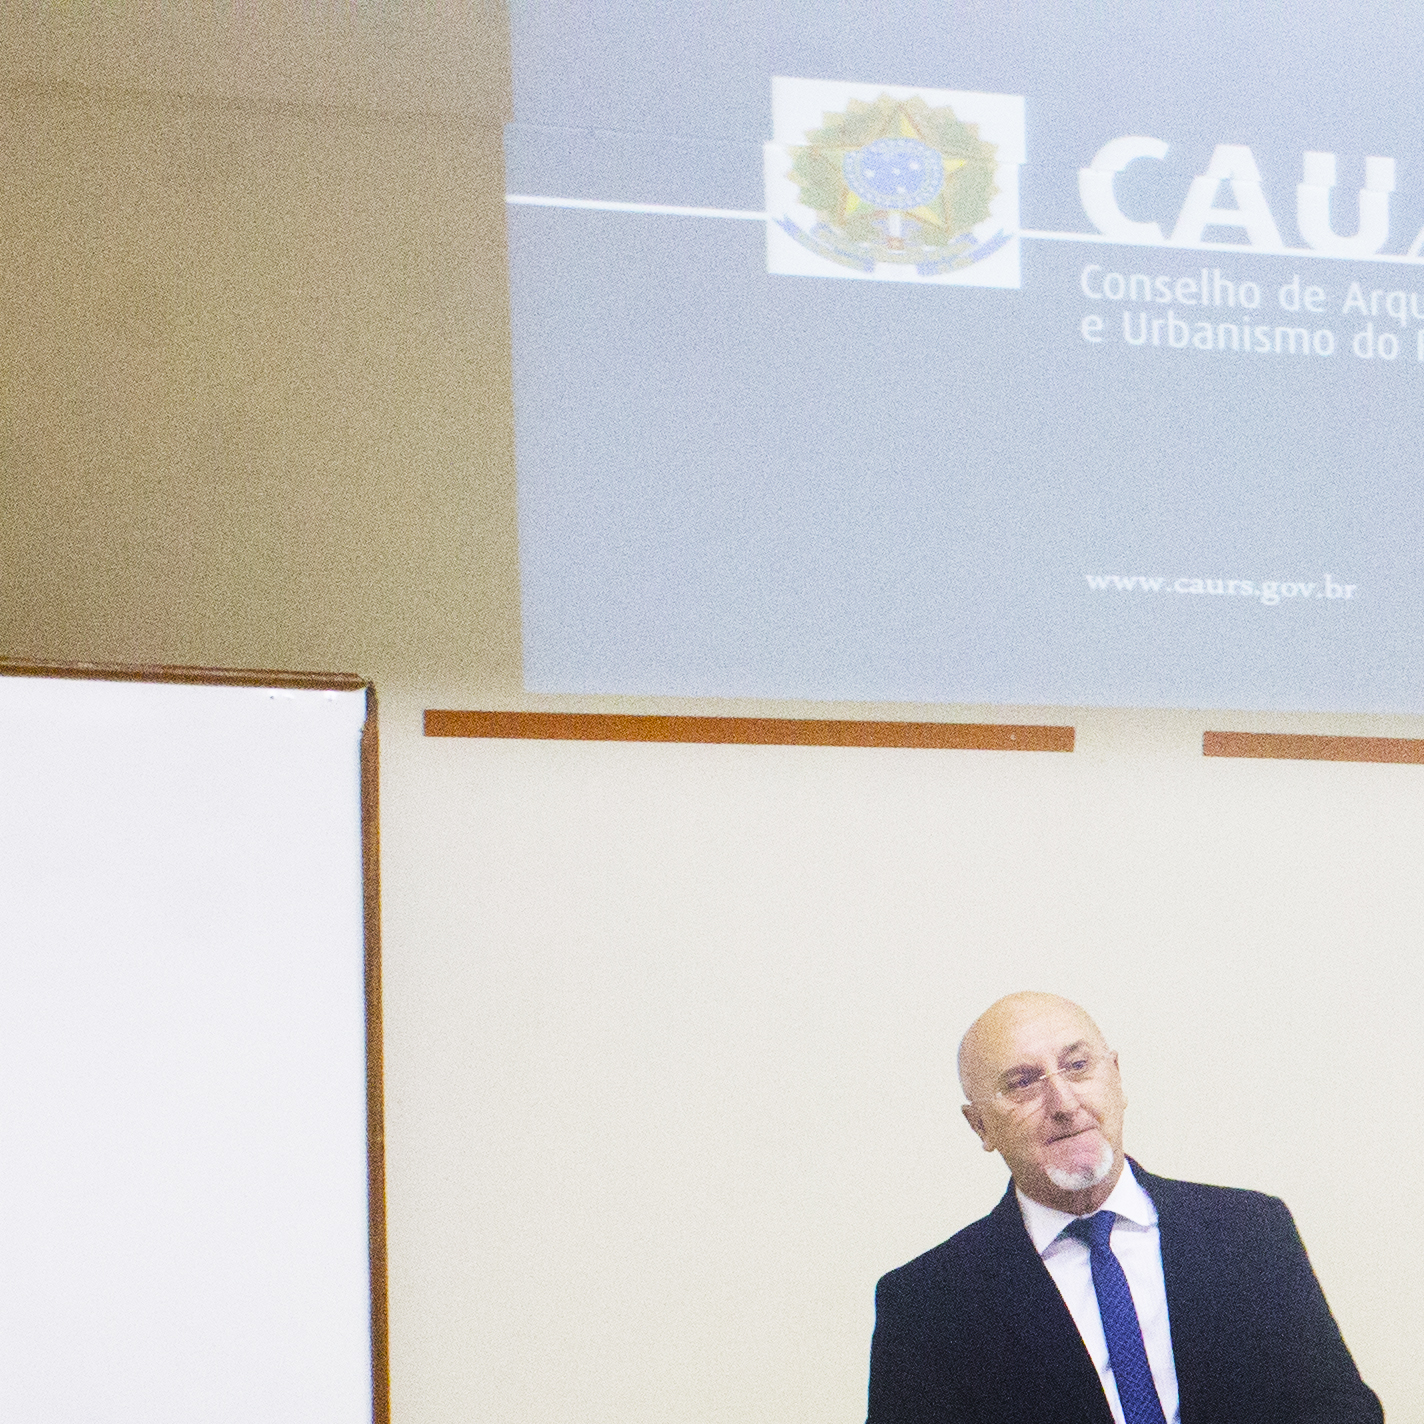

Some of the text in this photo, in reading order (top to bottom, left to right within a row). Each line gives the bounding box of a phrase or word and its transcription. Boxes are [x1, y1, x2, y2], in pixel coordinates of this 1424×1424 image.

[1079, 263, 1261, 309] Conselho
[1278, 273, 1326, 313] de
[1081, 313, 1104, 343] e
[1122, 309, 1335, 356] Urbanismo
[1353, 321, 1400, 361] do
[1085, 573, 1357, 606] www.caurs.gov.br
